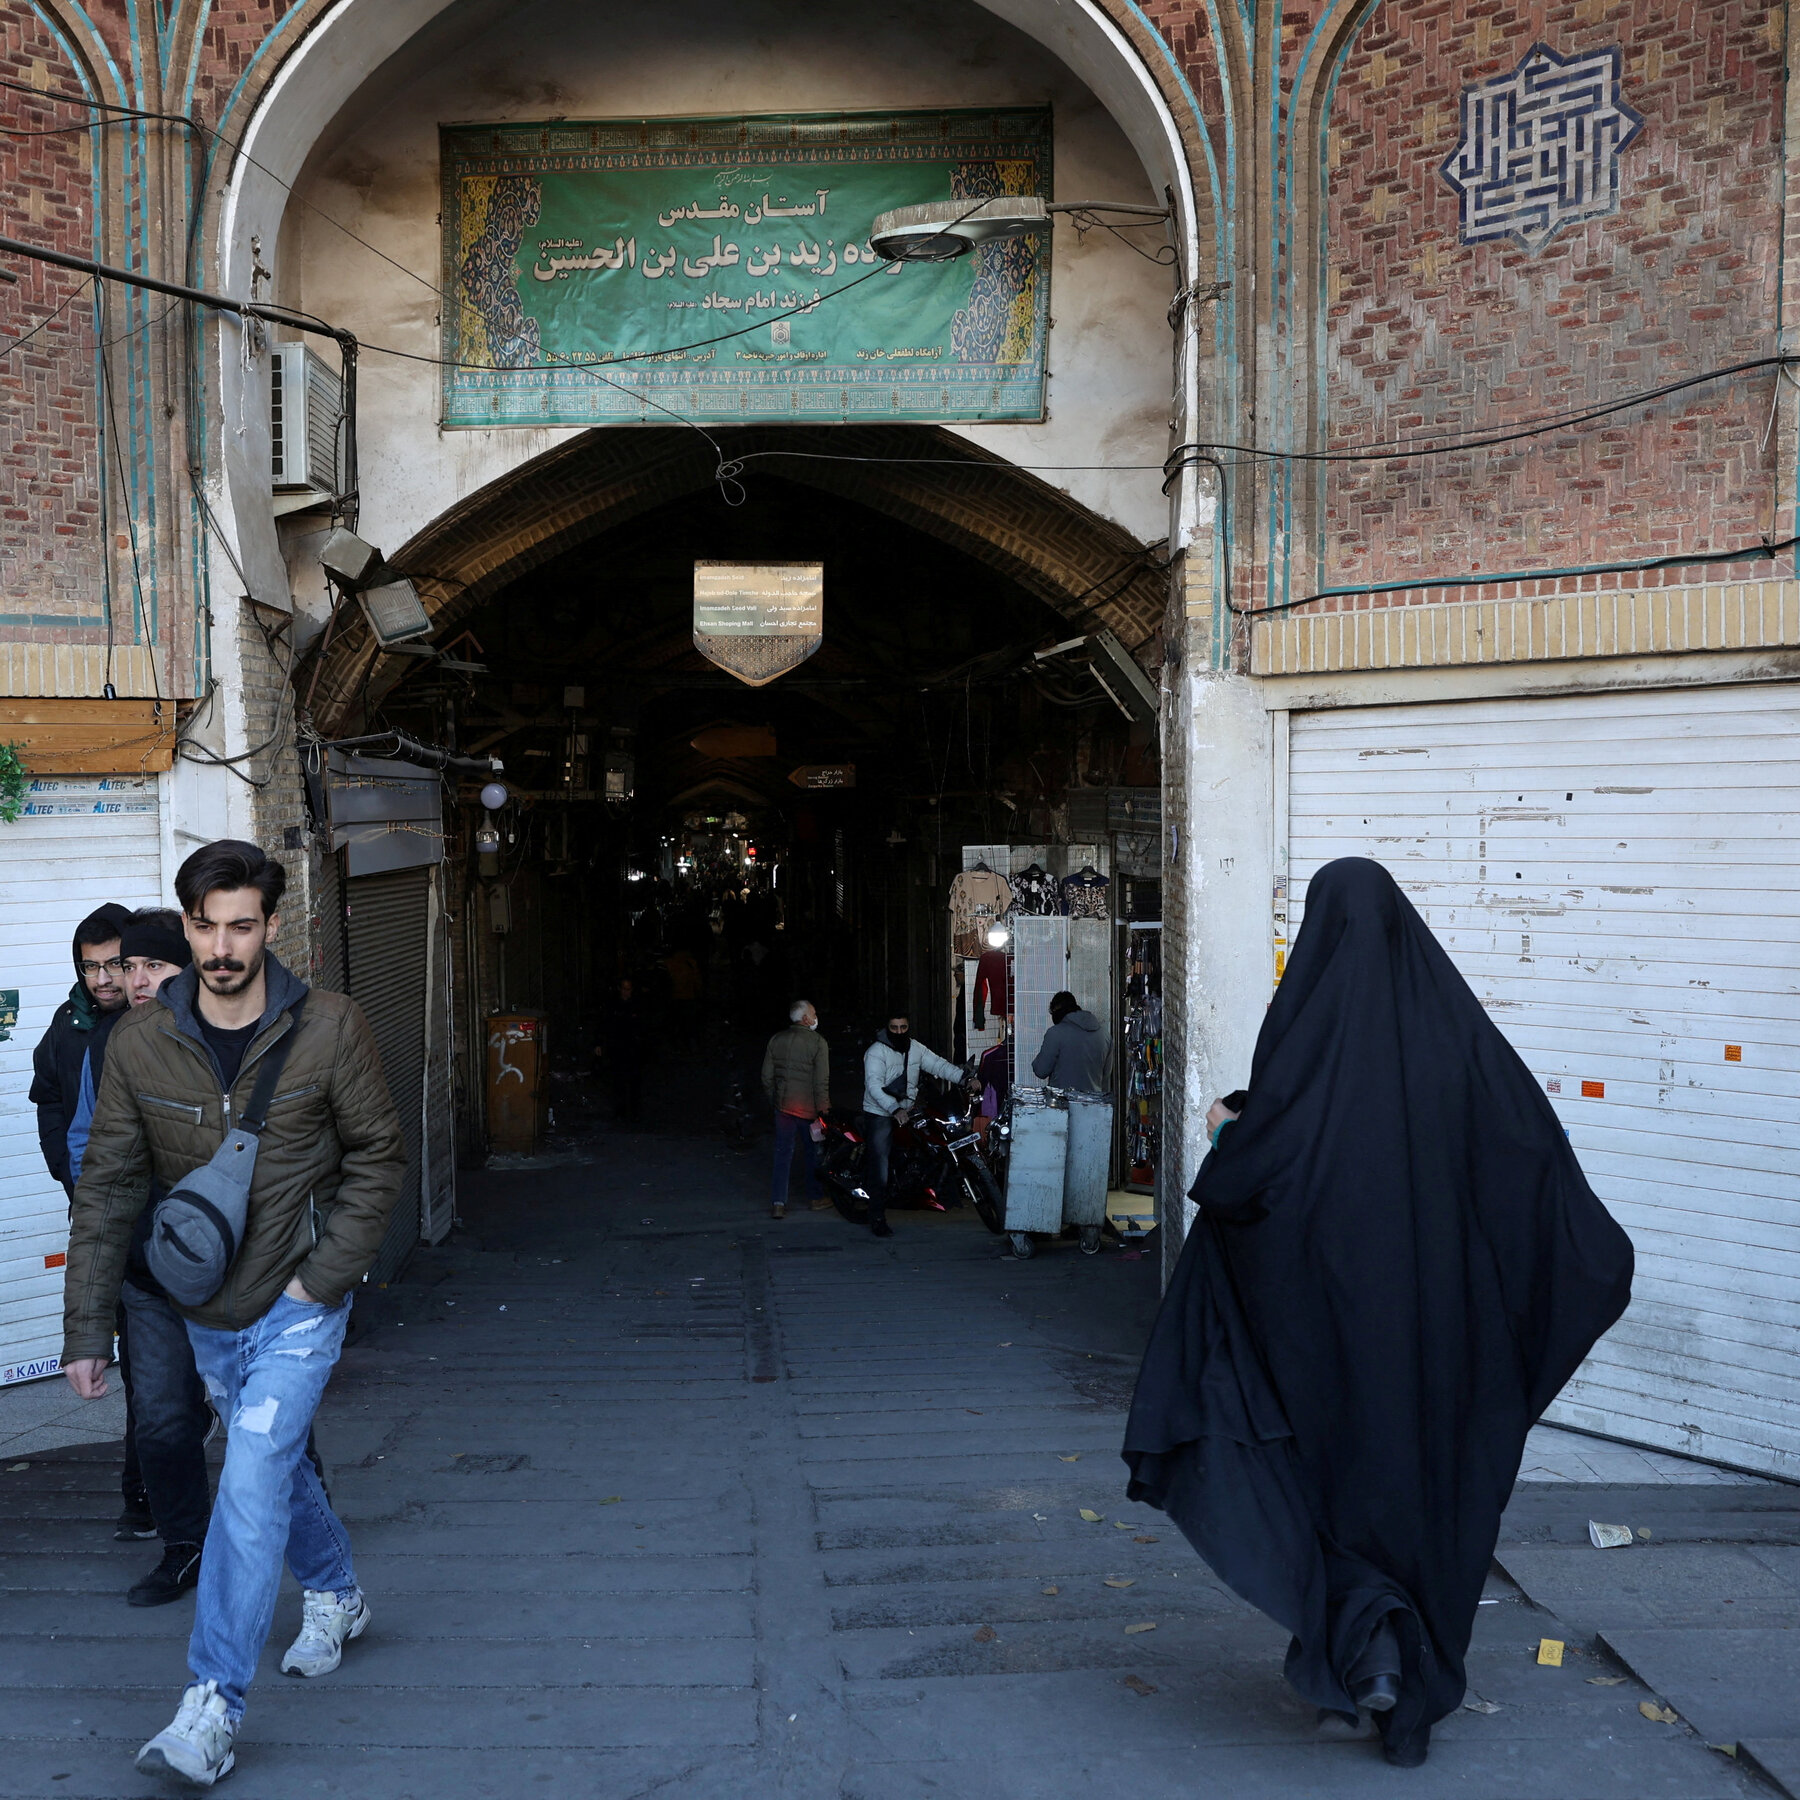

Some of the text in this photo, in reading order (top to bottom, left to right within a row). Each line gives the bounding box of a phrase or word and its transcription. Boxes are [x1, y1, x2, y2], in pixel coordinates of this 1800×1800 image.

[658, 188, 830, 227] آستان مقدس
[533, 235, 637, 282] الحسین
[641, 245, 678, 279] بن
[682, 234, 741, 278] علی
[746, 242, 782, 277] بن
[790, 239, 837, 276] زید
[701, 288, 823, 314] فرزند امام سجاد
[856, 348, 869, 361] زند
[869, 348, 886, 360] خان
[16, 1359, 61, 1378] KAVIR
